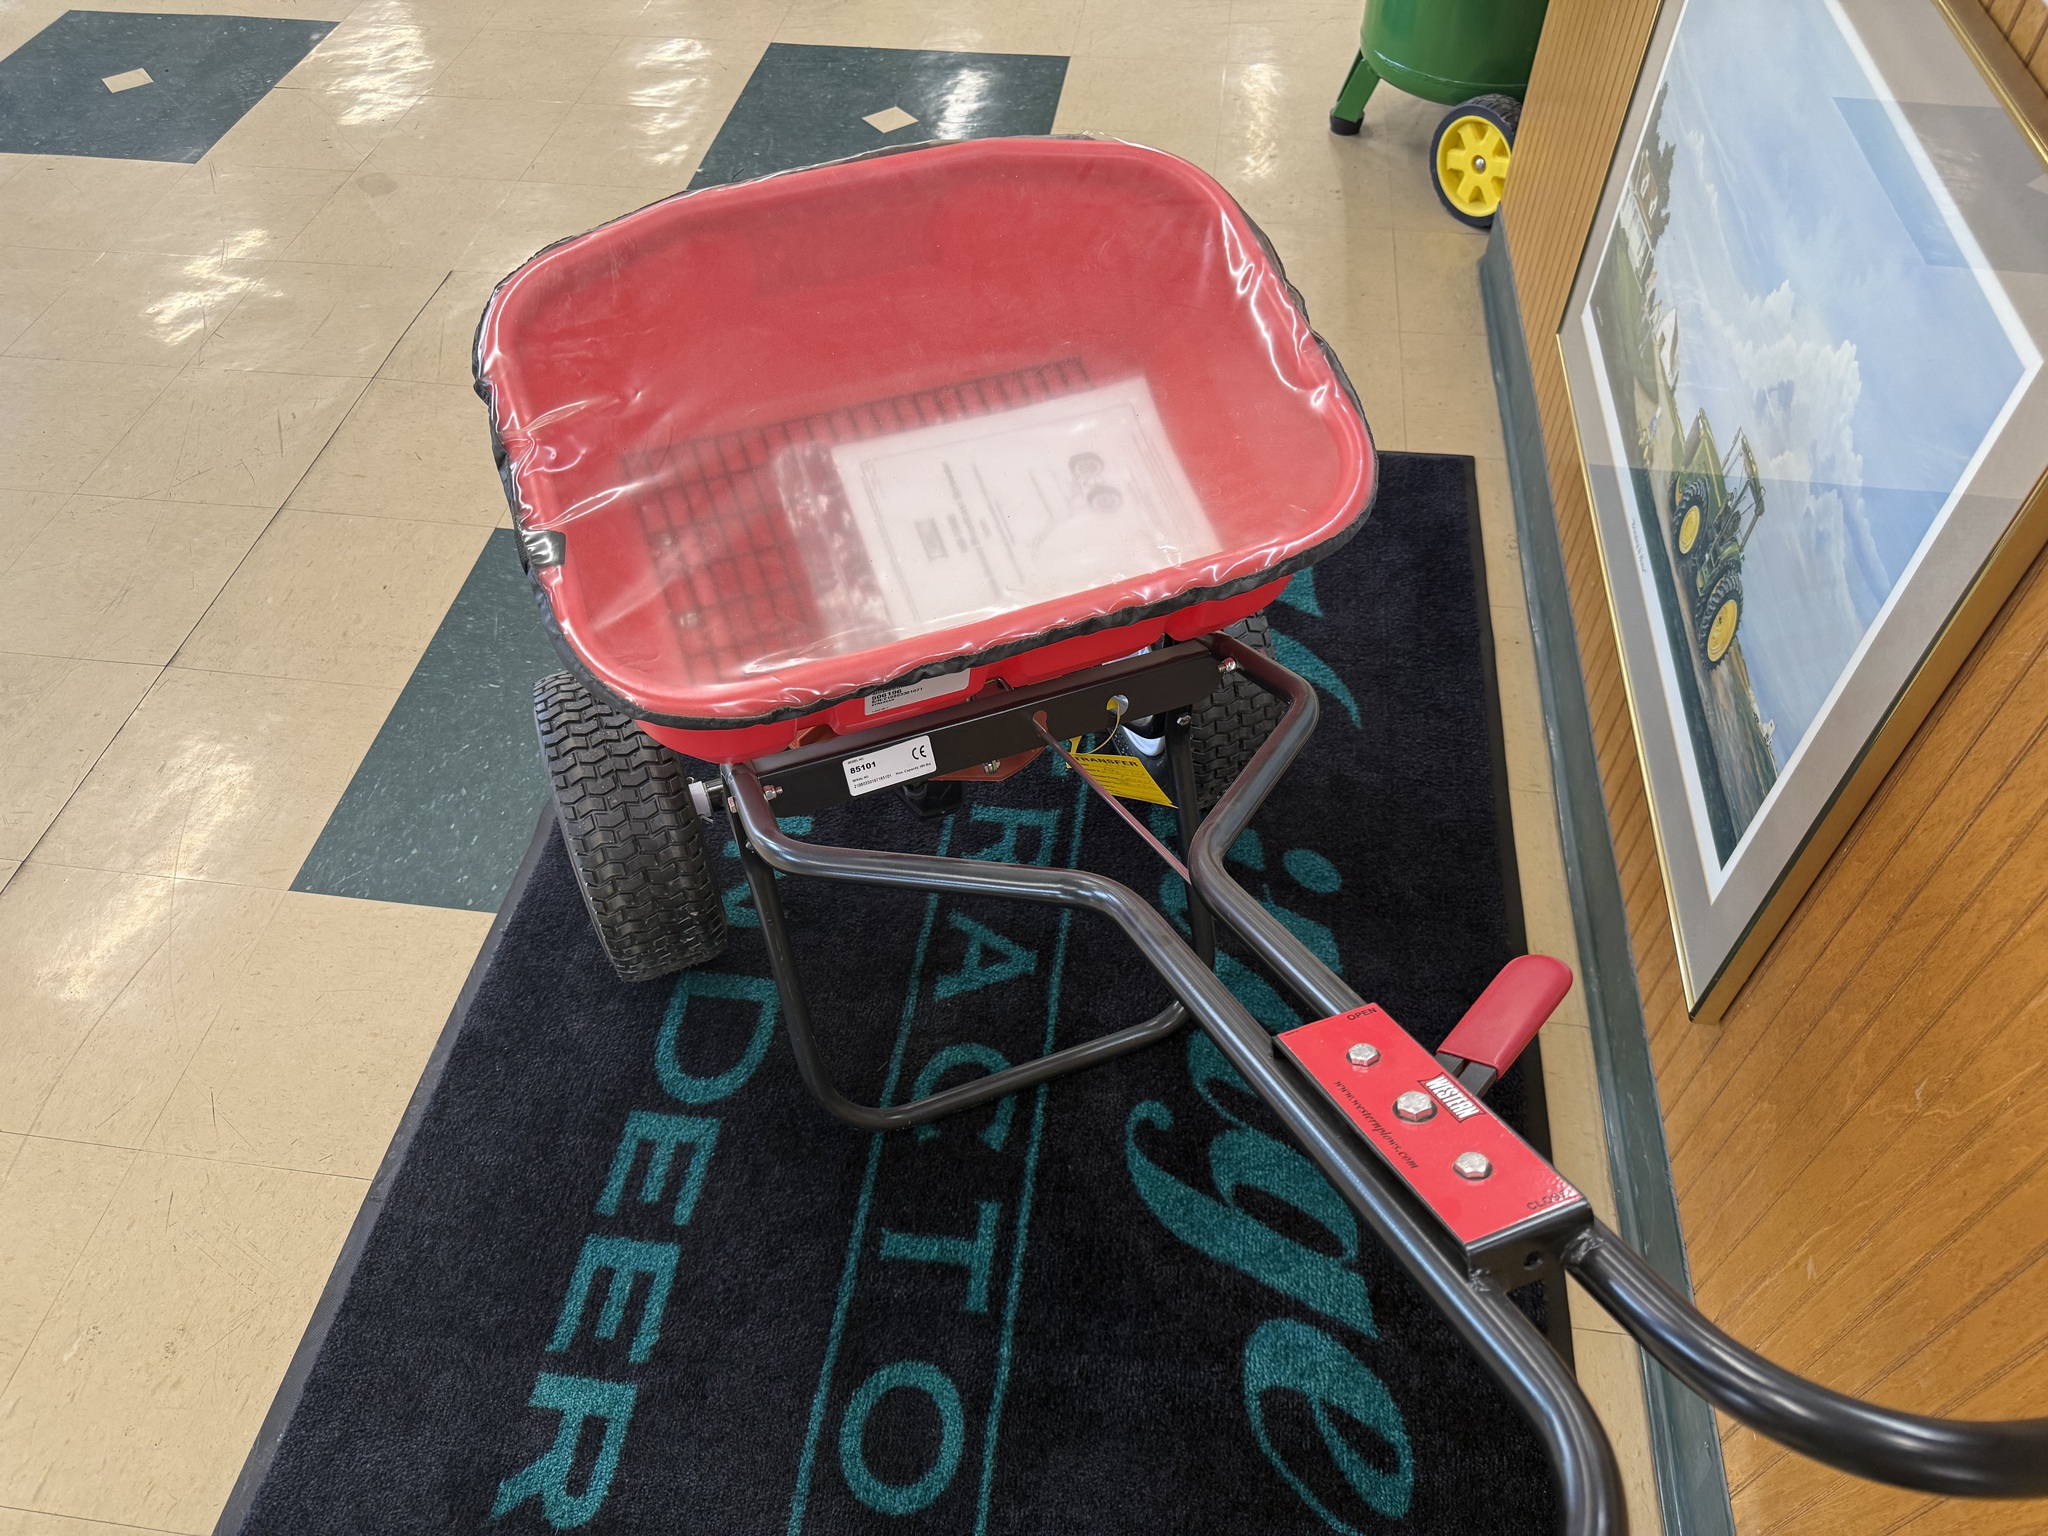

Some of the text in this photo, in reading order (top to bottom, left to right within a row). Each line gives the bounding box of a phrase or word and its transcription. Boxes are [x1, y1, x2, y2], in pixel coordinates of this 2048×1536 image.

[849, 761, 877, 774] 85101
[1347, 1007, 1377, 1021] OPEN
[1425, 1075, 1480, 1119] WESTERN
[839, 738, 1072, 1516] RACTO
[1334, 1081, 1419, 1169] www.westernplows.com
